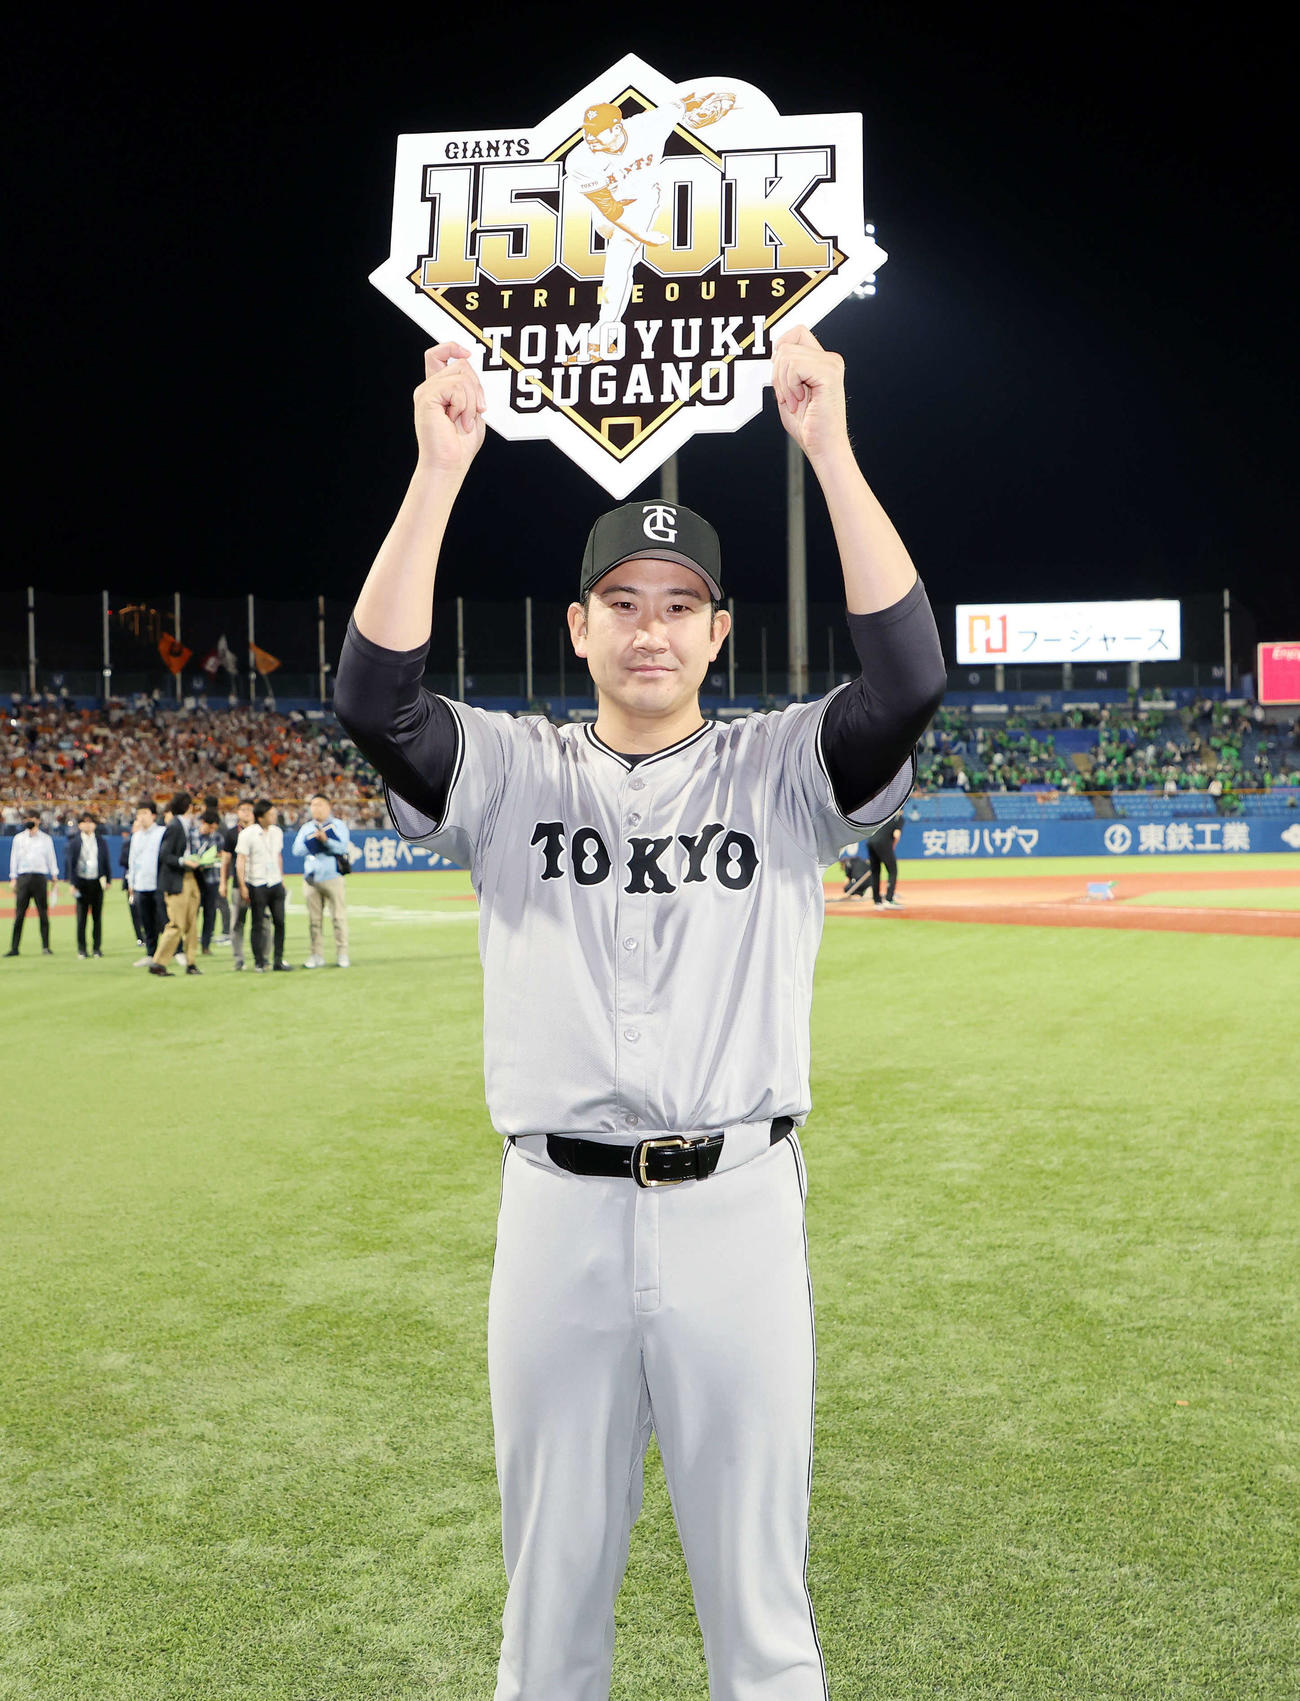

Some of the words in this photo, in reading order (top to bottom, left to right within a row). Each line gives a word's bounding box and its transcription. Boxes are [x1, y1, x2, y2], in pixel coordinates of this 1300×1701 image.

[445, 138, 530, 159] GIANTS
[465, 278, 786, 311] STRIKEOUTS
[482, 315, 766, 366] TOMOYUKI
[516, 361, 730, 408] SUGANO
[1018, 625, 1169, 652] フージャース
[922, 826, 1039, 857] 安藤ハザマ
[1138, 822, 1250, 854] 東鉄工業
[530, 820, 760, 895] TOKYO
